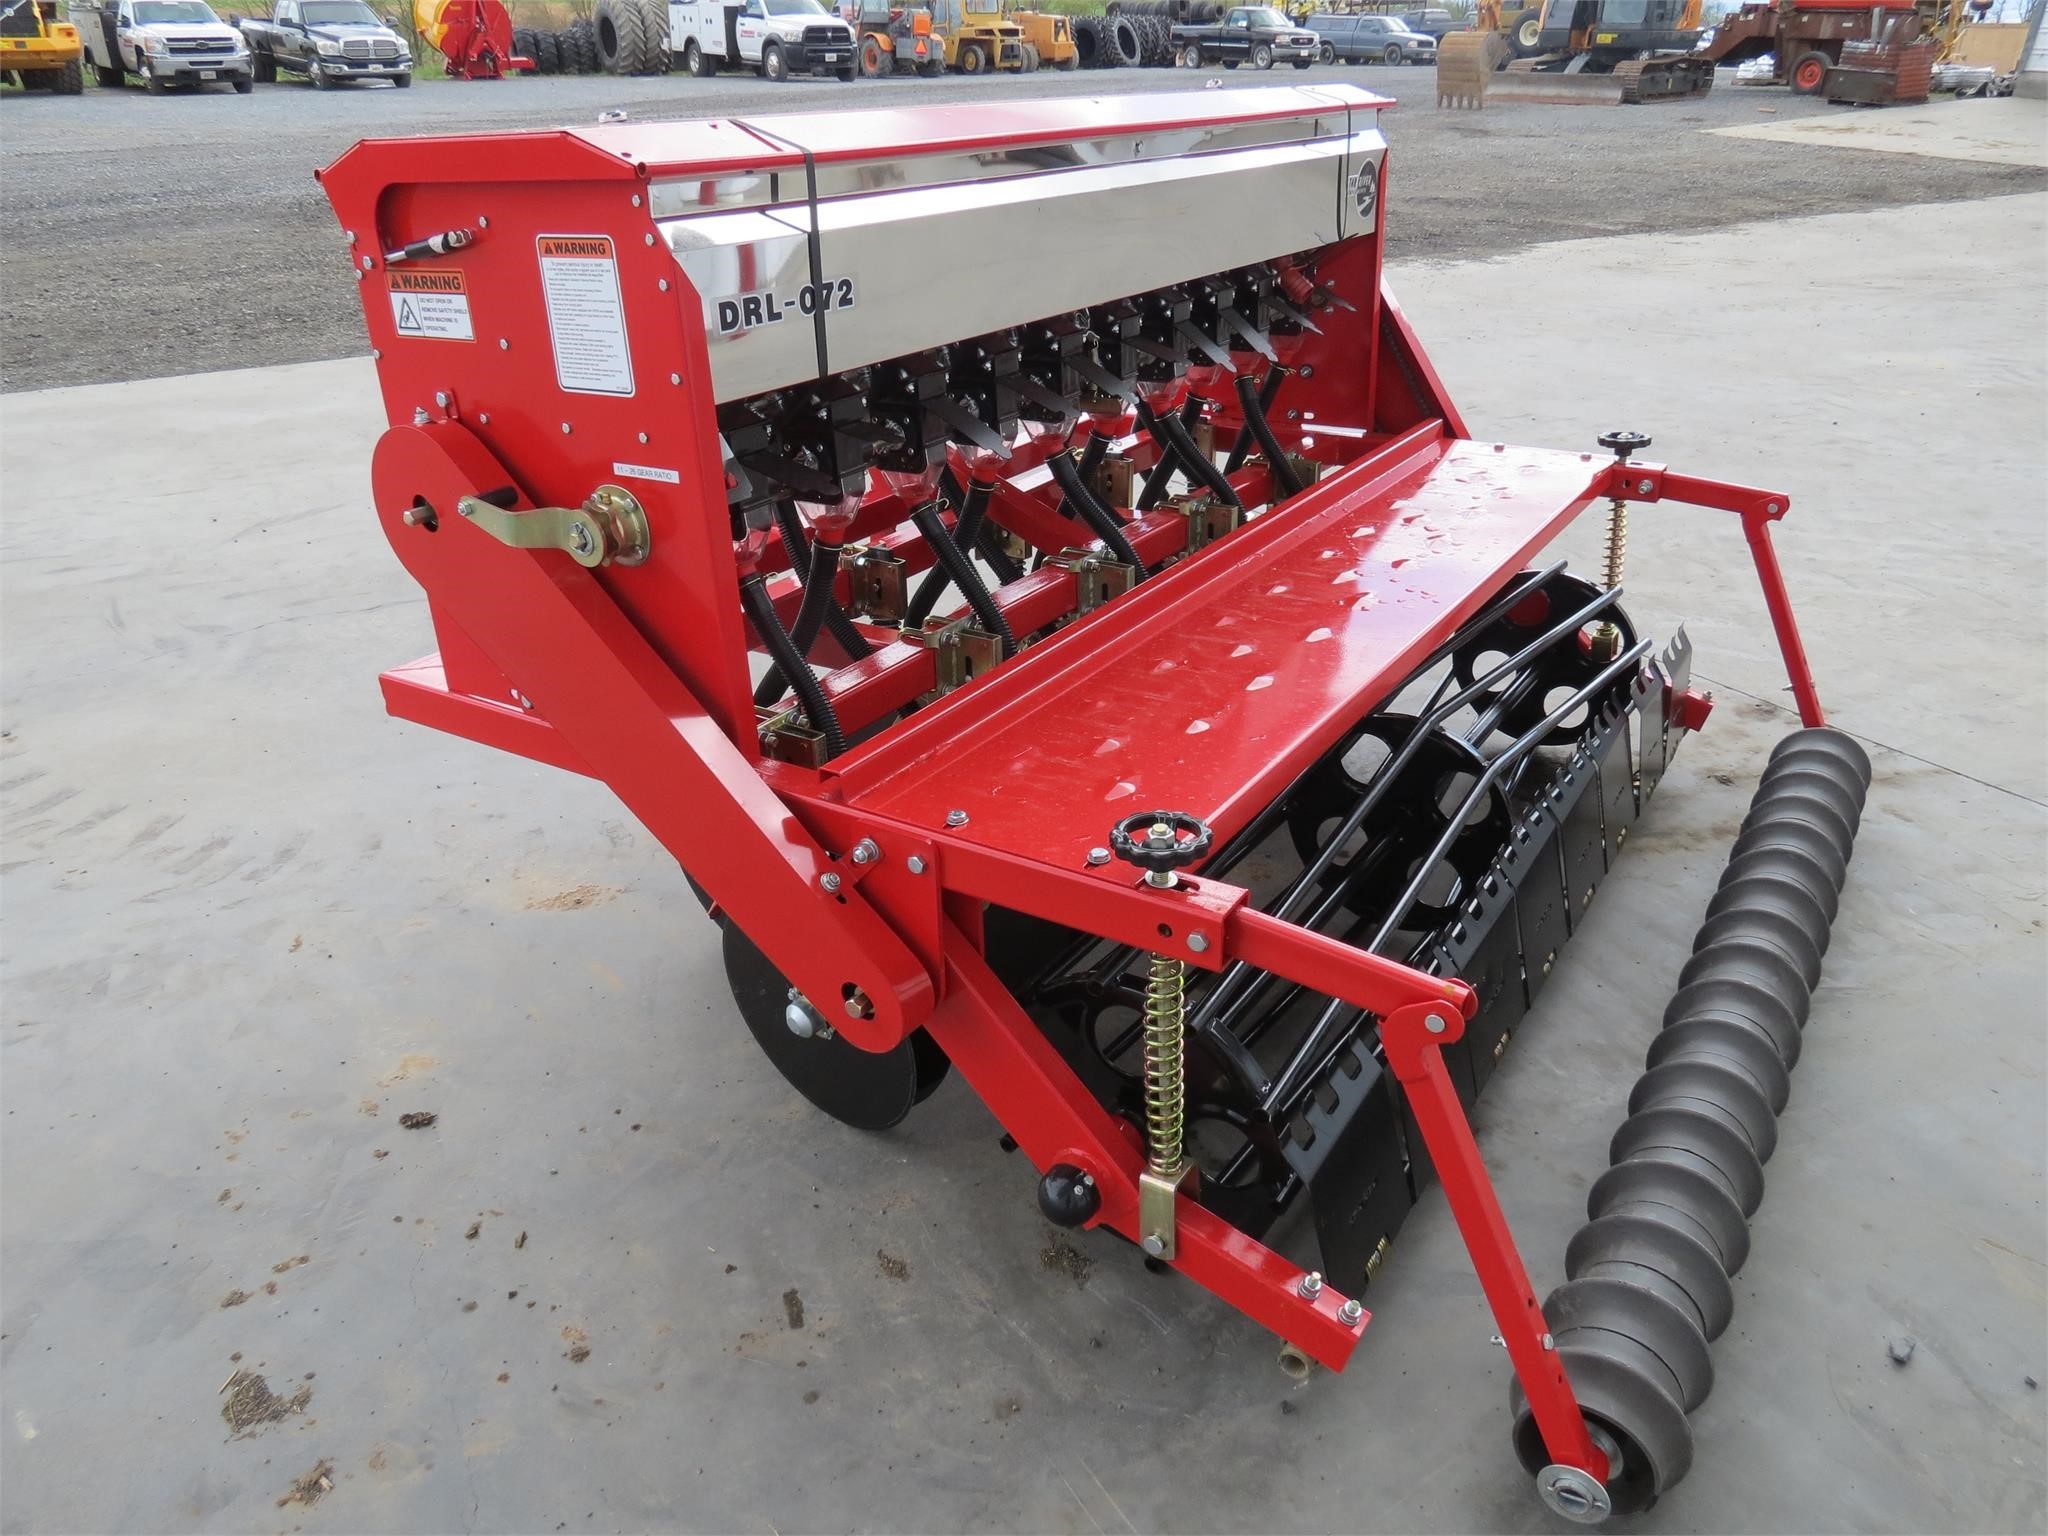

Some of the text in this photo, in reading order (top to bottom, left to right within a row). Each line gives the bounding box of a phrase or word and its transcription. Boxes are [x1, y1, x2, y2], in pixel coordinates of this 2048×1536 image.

[553, 242, 606, 255] WARNING
[400, 274, 461, 290] WARNING
[718, 278, 854, 332] DRL-072
